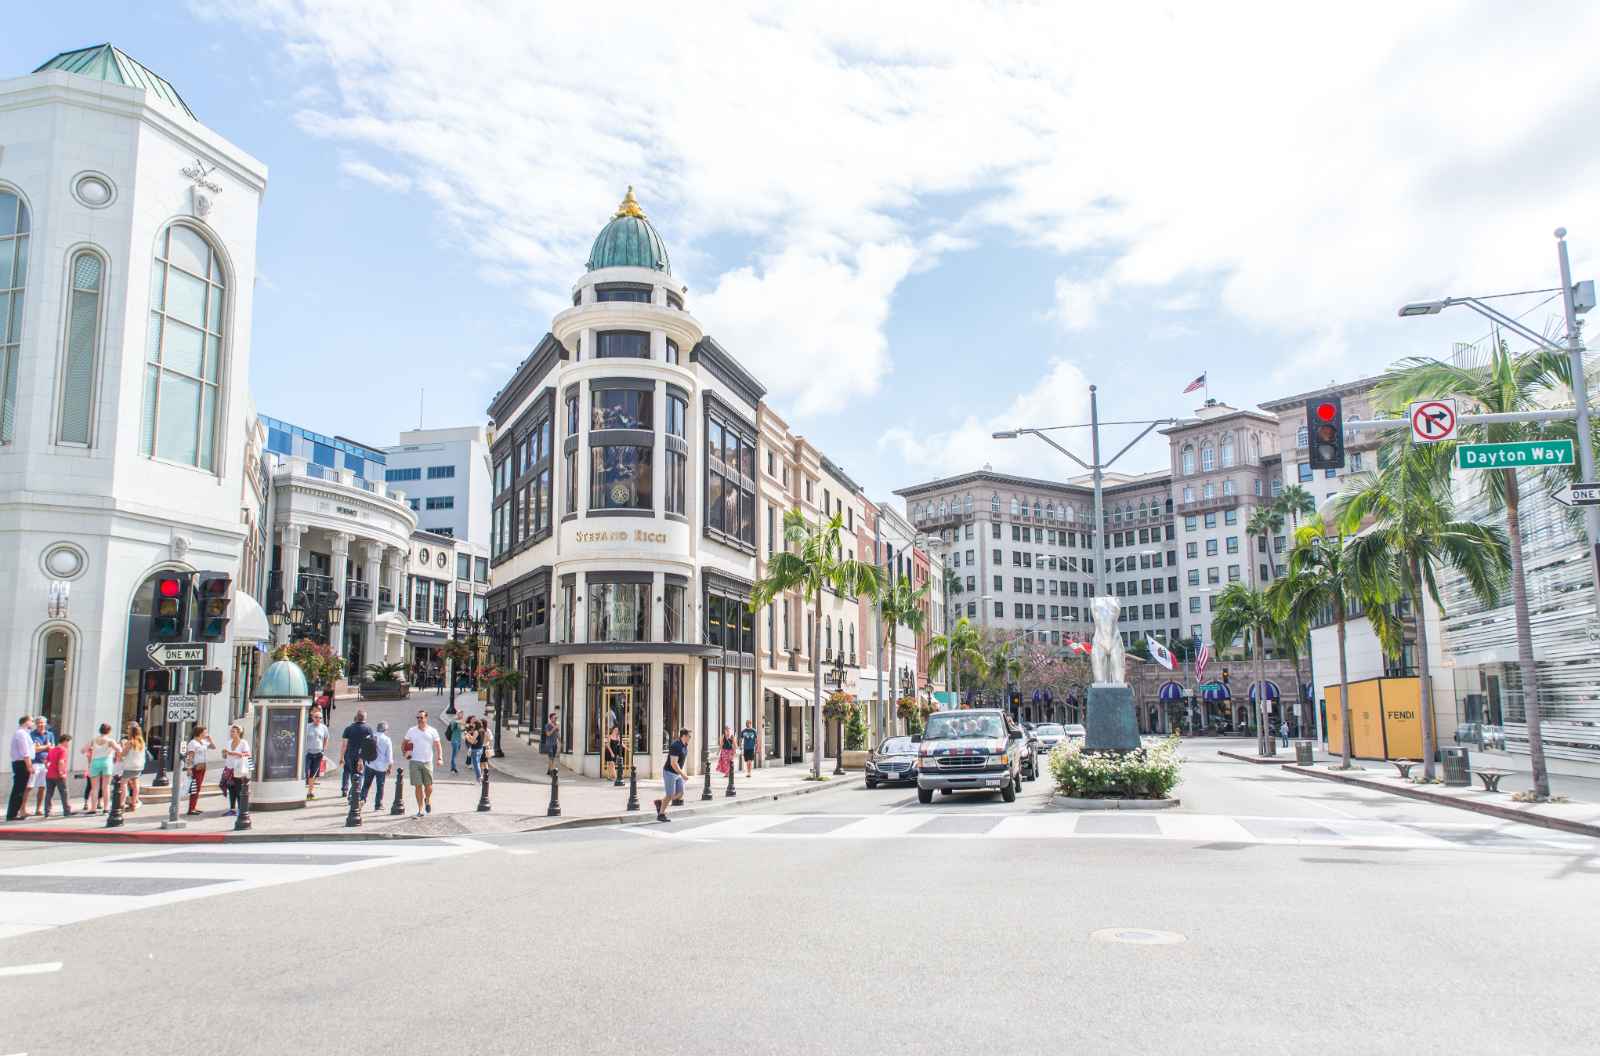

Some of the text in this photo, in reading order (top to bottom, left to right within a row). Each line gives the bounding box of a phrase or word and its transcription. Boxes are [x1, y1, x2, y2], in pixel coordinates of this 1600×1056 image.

[1466, 447, 1565, 465] Dayton Way
[1572, 491, 1595, 499] ONE
[166, 650, 200, 659] ONE WAY
[168, 710, 180, 720] OK
[1388, 711, 1415, 720] FENDI
